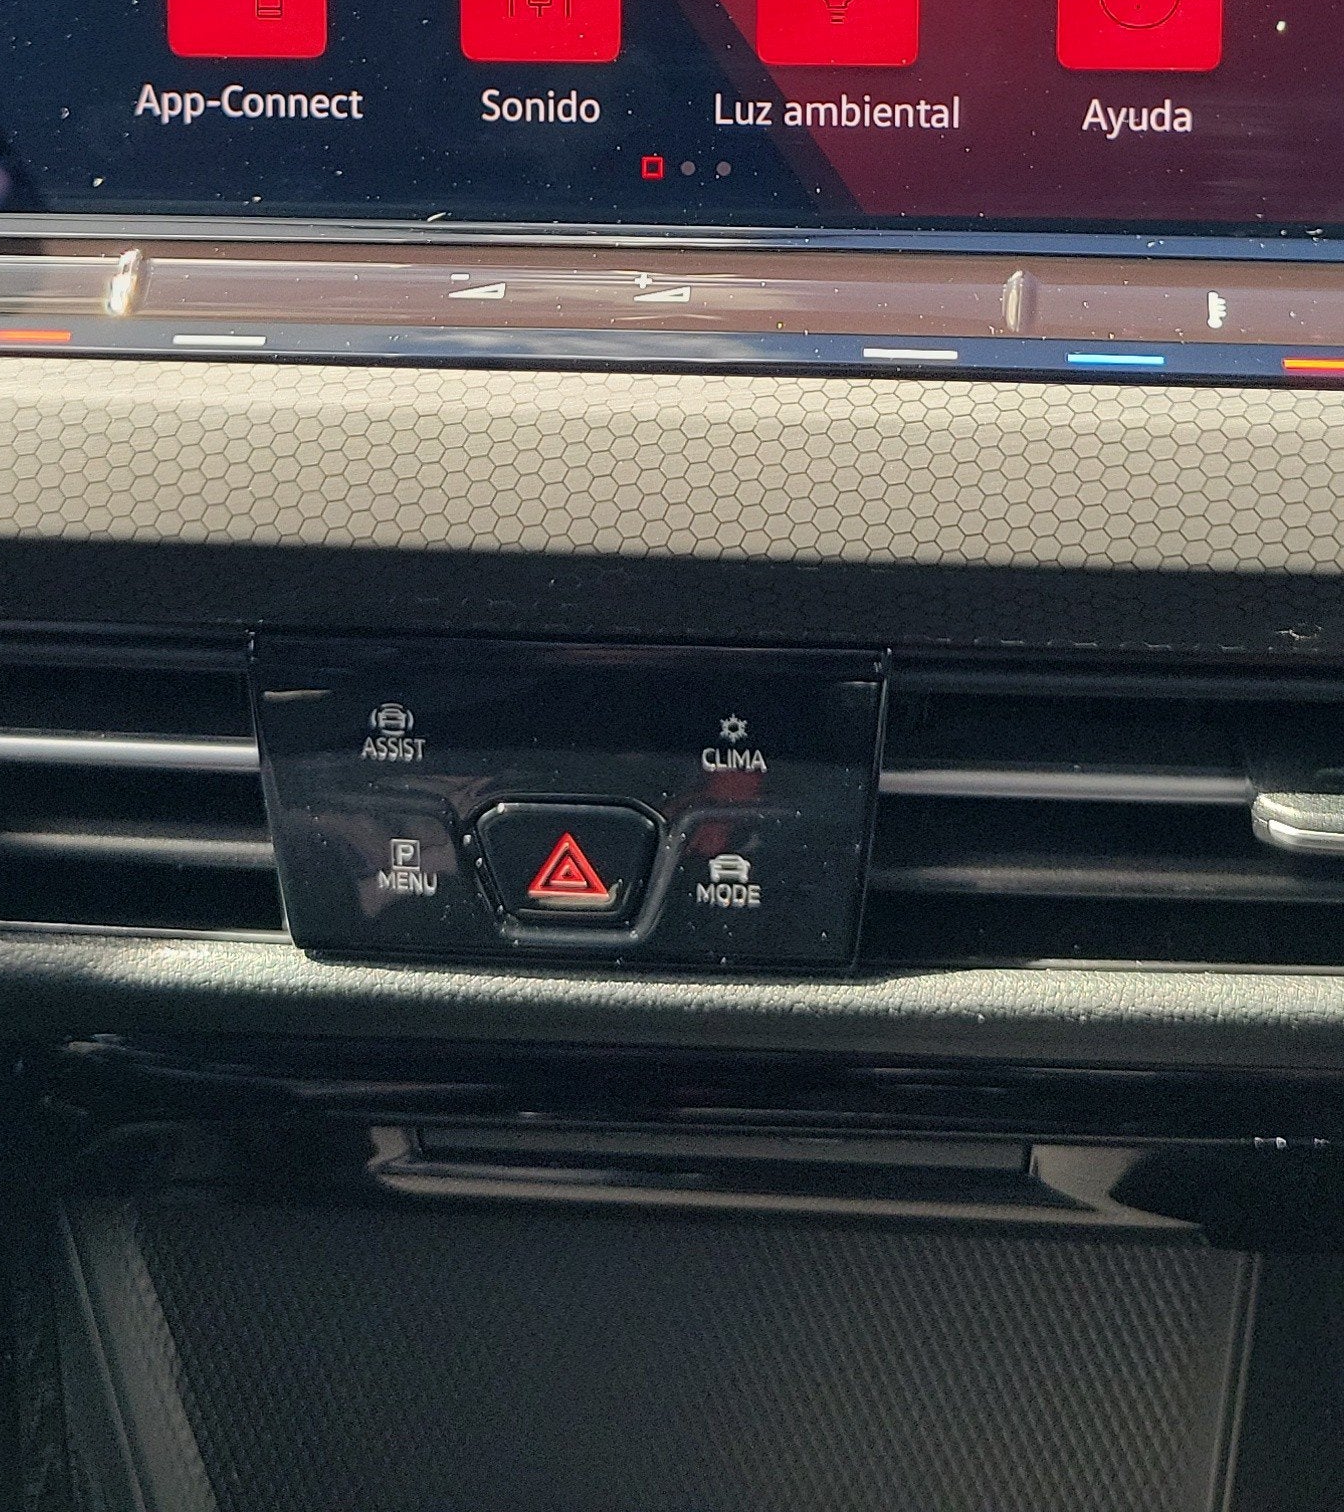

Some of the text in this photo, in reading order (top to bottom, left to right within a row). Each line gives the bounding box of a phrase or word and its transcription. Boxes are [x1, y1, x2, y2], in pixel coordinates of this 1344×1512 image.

[135, 83, 364, 125] App-Connect
[481, 88, 601, 124] Sonido
[714, 92, 960, 130] Luz ambiental
[1081, 97, 1193, 140] Ayuda
[361, 736, 426, 762] ASSIST
[702, 747, 768, 773] CLIMA
[377, 869, 438, 896] MENU
[696, 883, 761, 908] MODE
